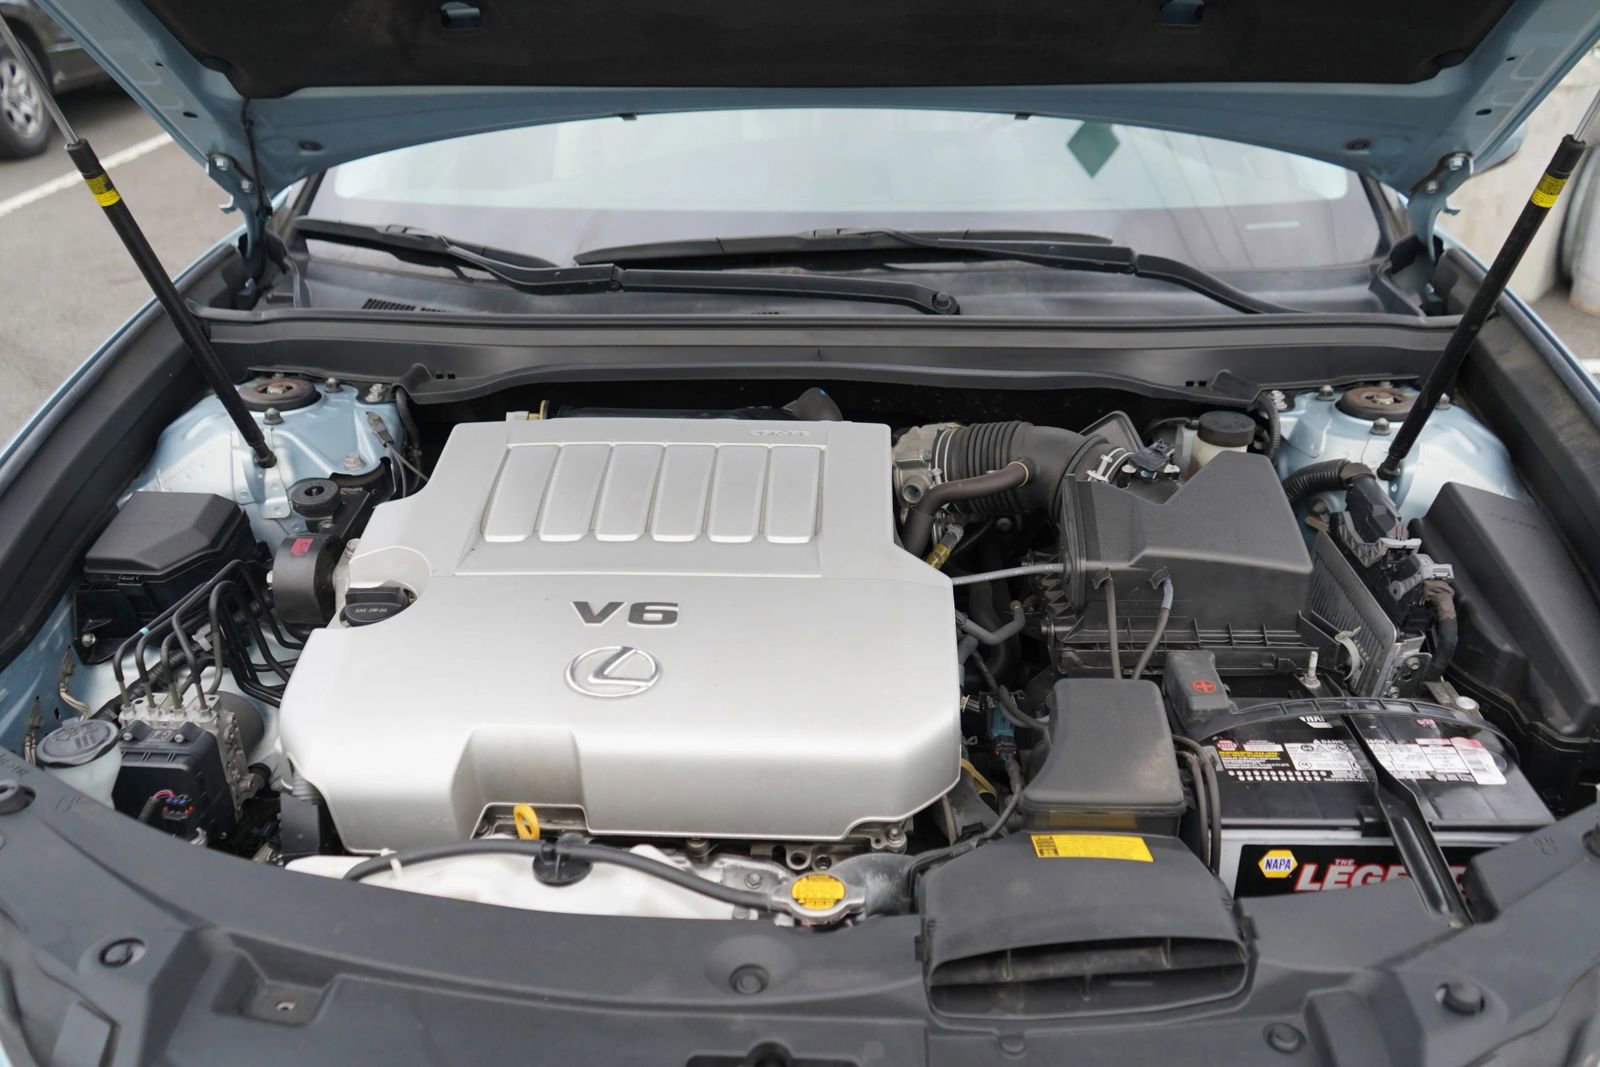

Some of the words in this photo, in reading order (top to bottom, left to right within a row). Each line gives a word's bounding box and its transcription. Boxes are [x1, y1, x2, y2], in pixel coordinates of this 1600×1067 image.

[572, 600, 679, 626] V6
[1264, 857, 1292, 870] NAPA
[1335, 858, 1355, 866] THE
[1294, 863, 1467, 893] LEG
